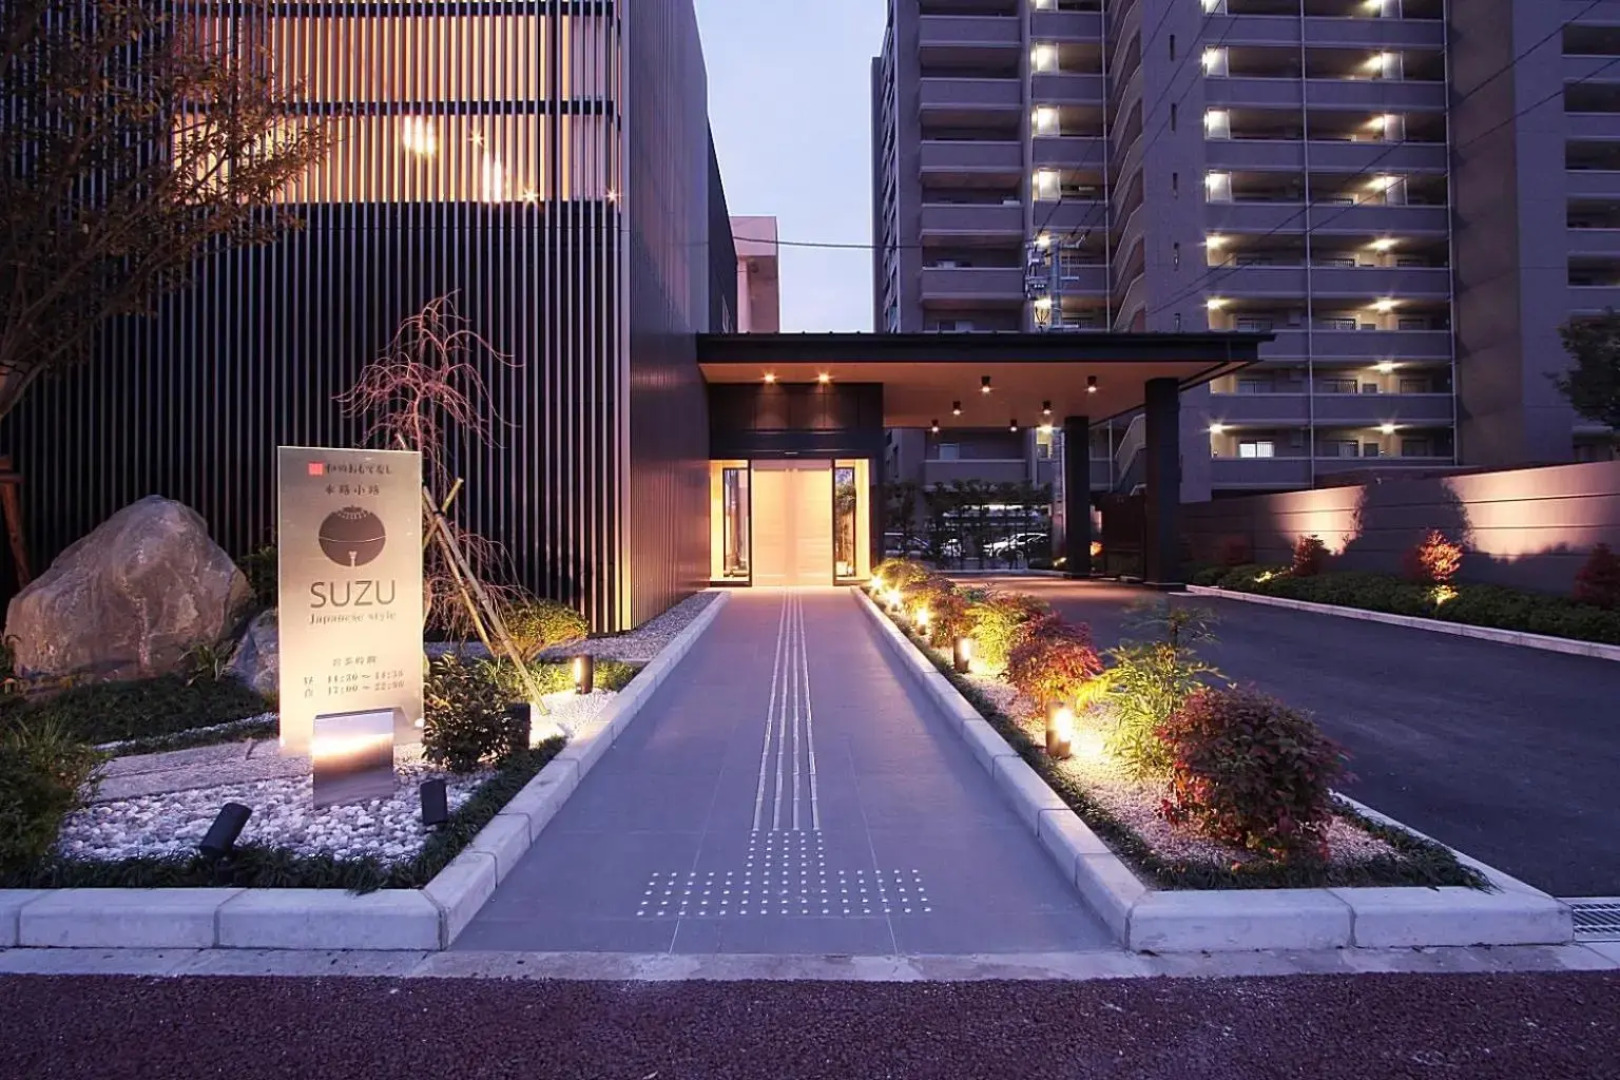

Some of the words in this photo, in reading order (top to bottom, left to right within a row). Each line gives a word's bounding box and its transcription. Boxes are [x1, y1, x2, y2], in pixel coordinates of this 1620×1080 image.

[310, 580, 395, 608] SUZU
[310, 613, 364, 625] Japanese
[369, 611, 396, 622] style
